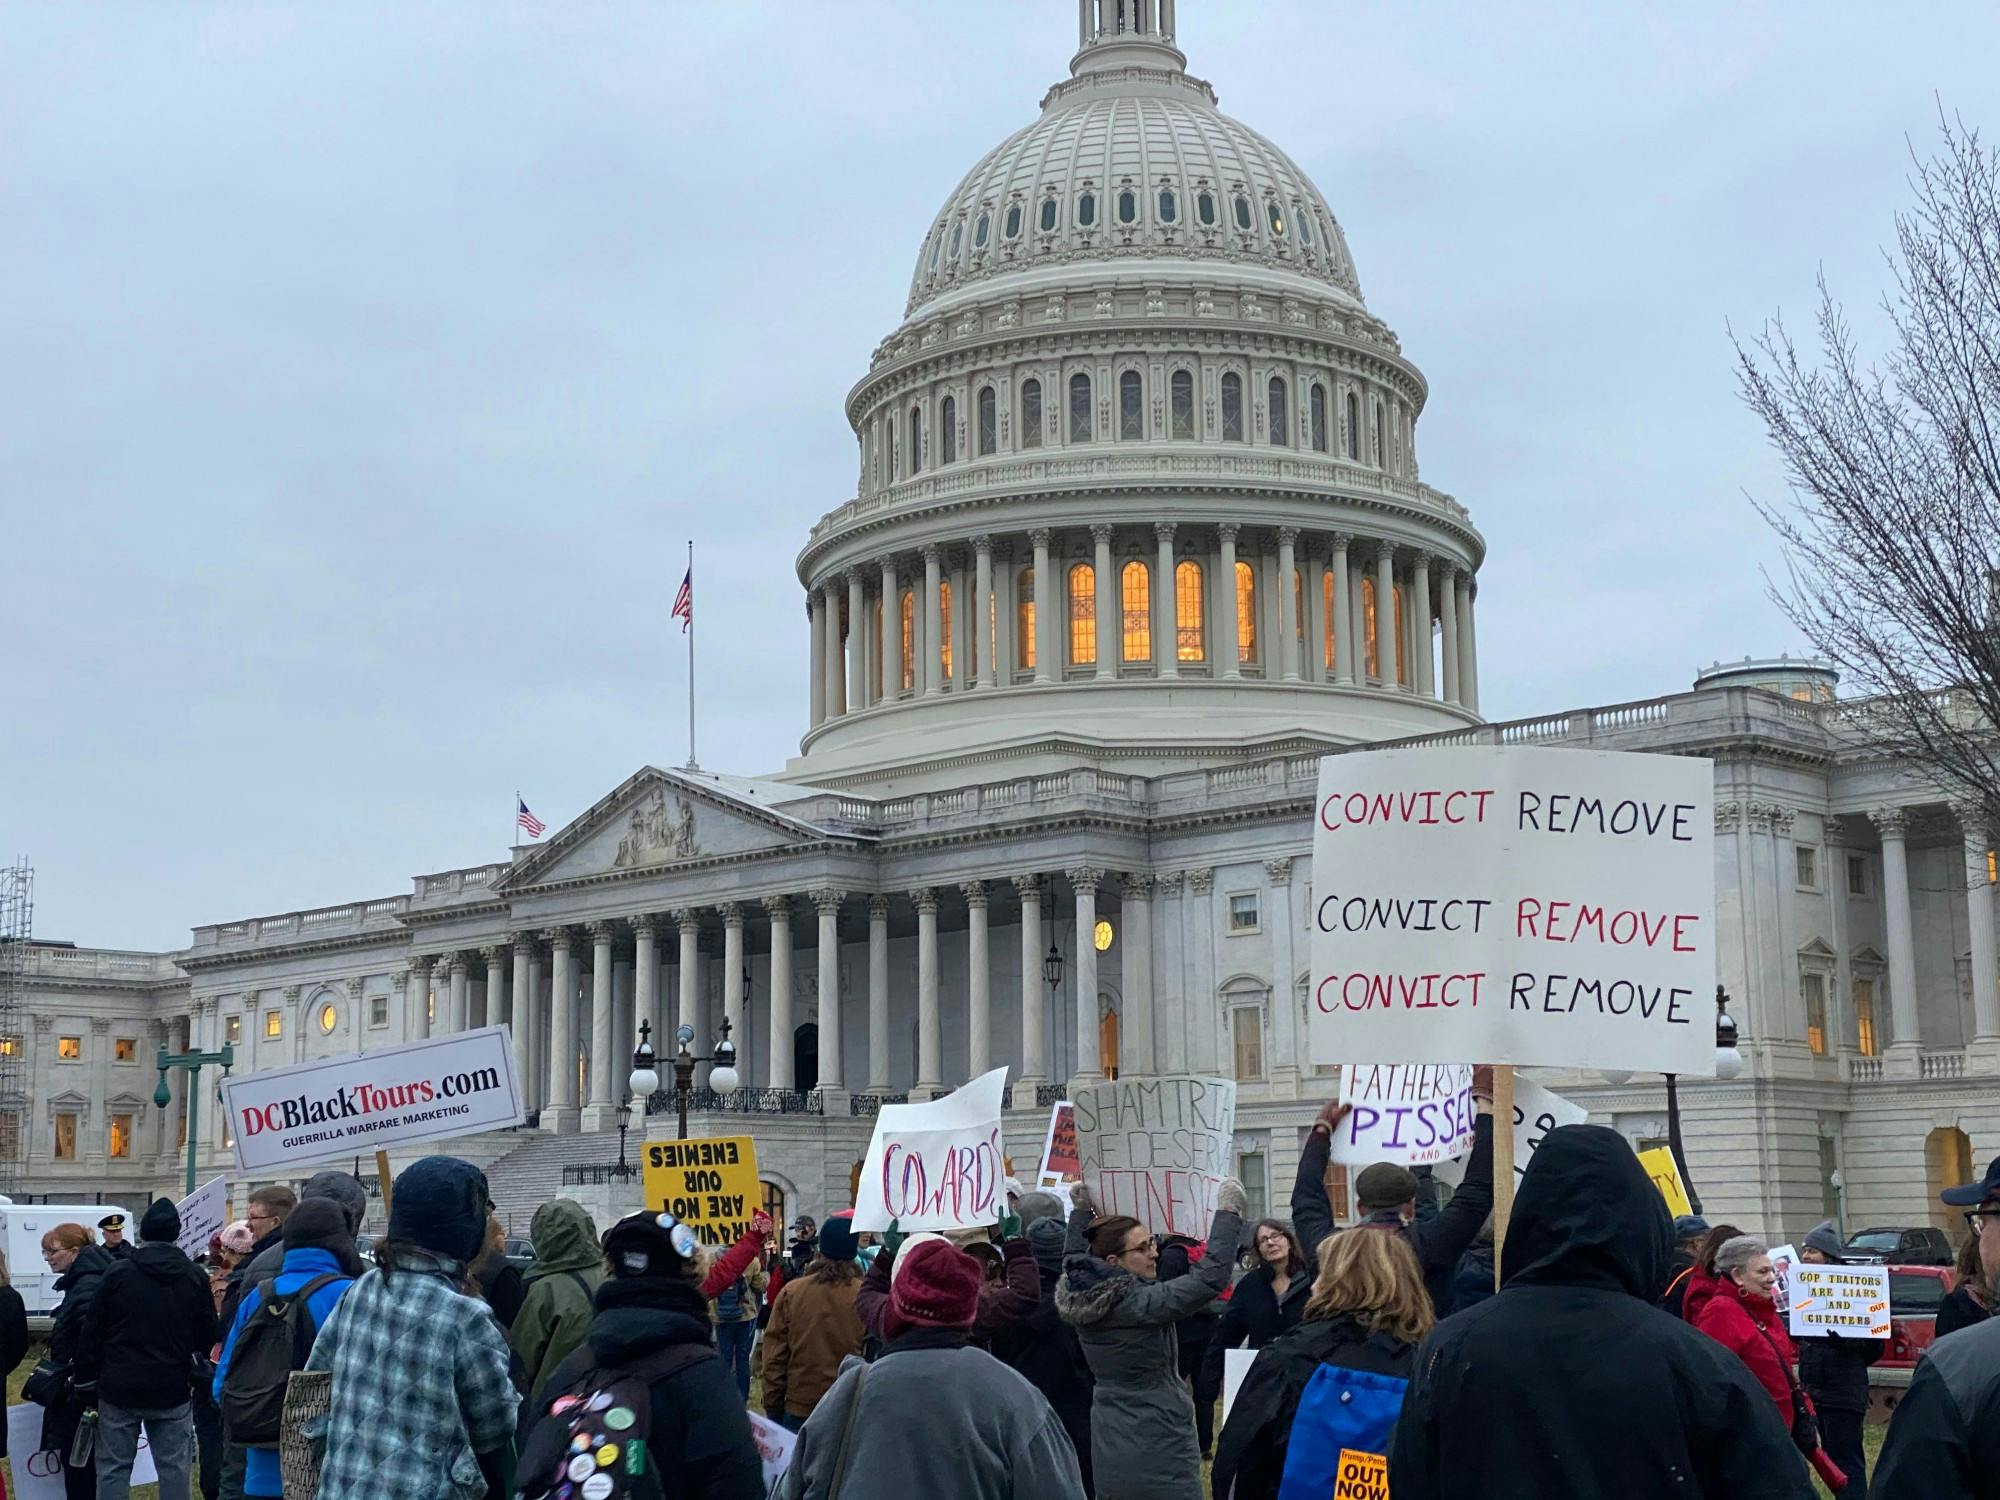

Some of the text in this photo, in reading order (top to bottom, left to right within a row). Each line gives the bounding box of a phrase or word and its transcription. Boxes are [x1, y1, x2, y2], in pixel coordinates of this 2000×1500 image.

[1320, 789, 1696, 842] CONVICT REMOVE
[1317, 895, 1699, 952] CONVICT REMOVE
[1316, 972, 1693, 1024] CONVICT REMOVE
[241, 1066, 501, 1137] DCBlackTours.com
[1074, 1080, 1164, 1133] SHAM
[282, 1103, 470, 1149] GUERRILLA WARFARE MARKETING
[649, 1142, 739, 1168] ENEMIES
[1079, 1133, 1123, 1170] WE
[683, 1170, 723, 1193] OUR
[883, 1128, 1004, 1224] COWARDS
[707, 1195, 744, 1218] ARE
[1799, 1272, 1881, 1286] GOP TRAITORS
[1810, 1287, 1878, 1298] ARE LIARS
[1828, 1301, 1851, 1310] AND
[1869, 1302, 1885, 1313] OUT
[1807, 1314, 1871, 1325] CHEATERS
[1870, 1324, 1889, 1336] NOW
[1343, 1463, 1385, 1486] OUT
[1337, 1480, 1387, 1500] NOW
